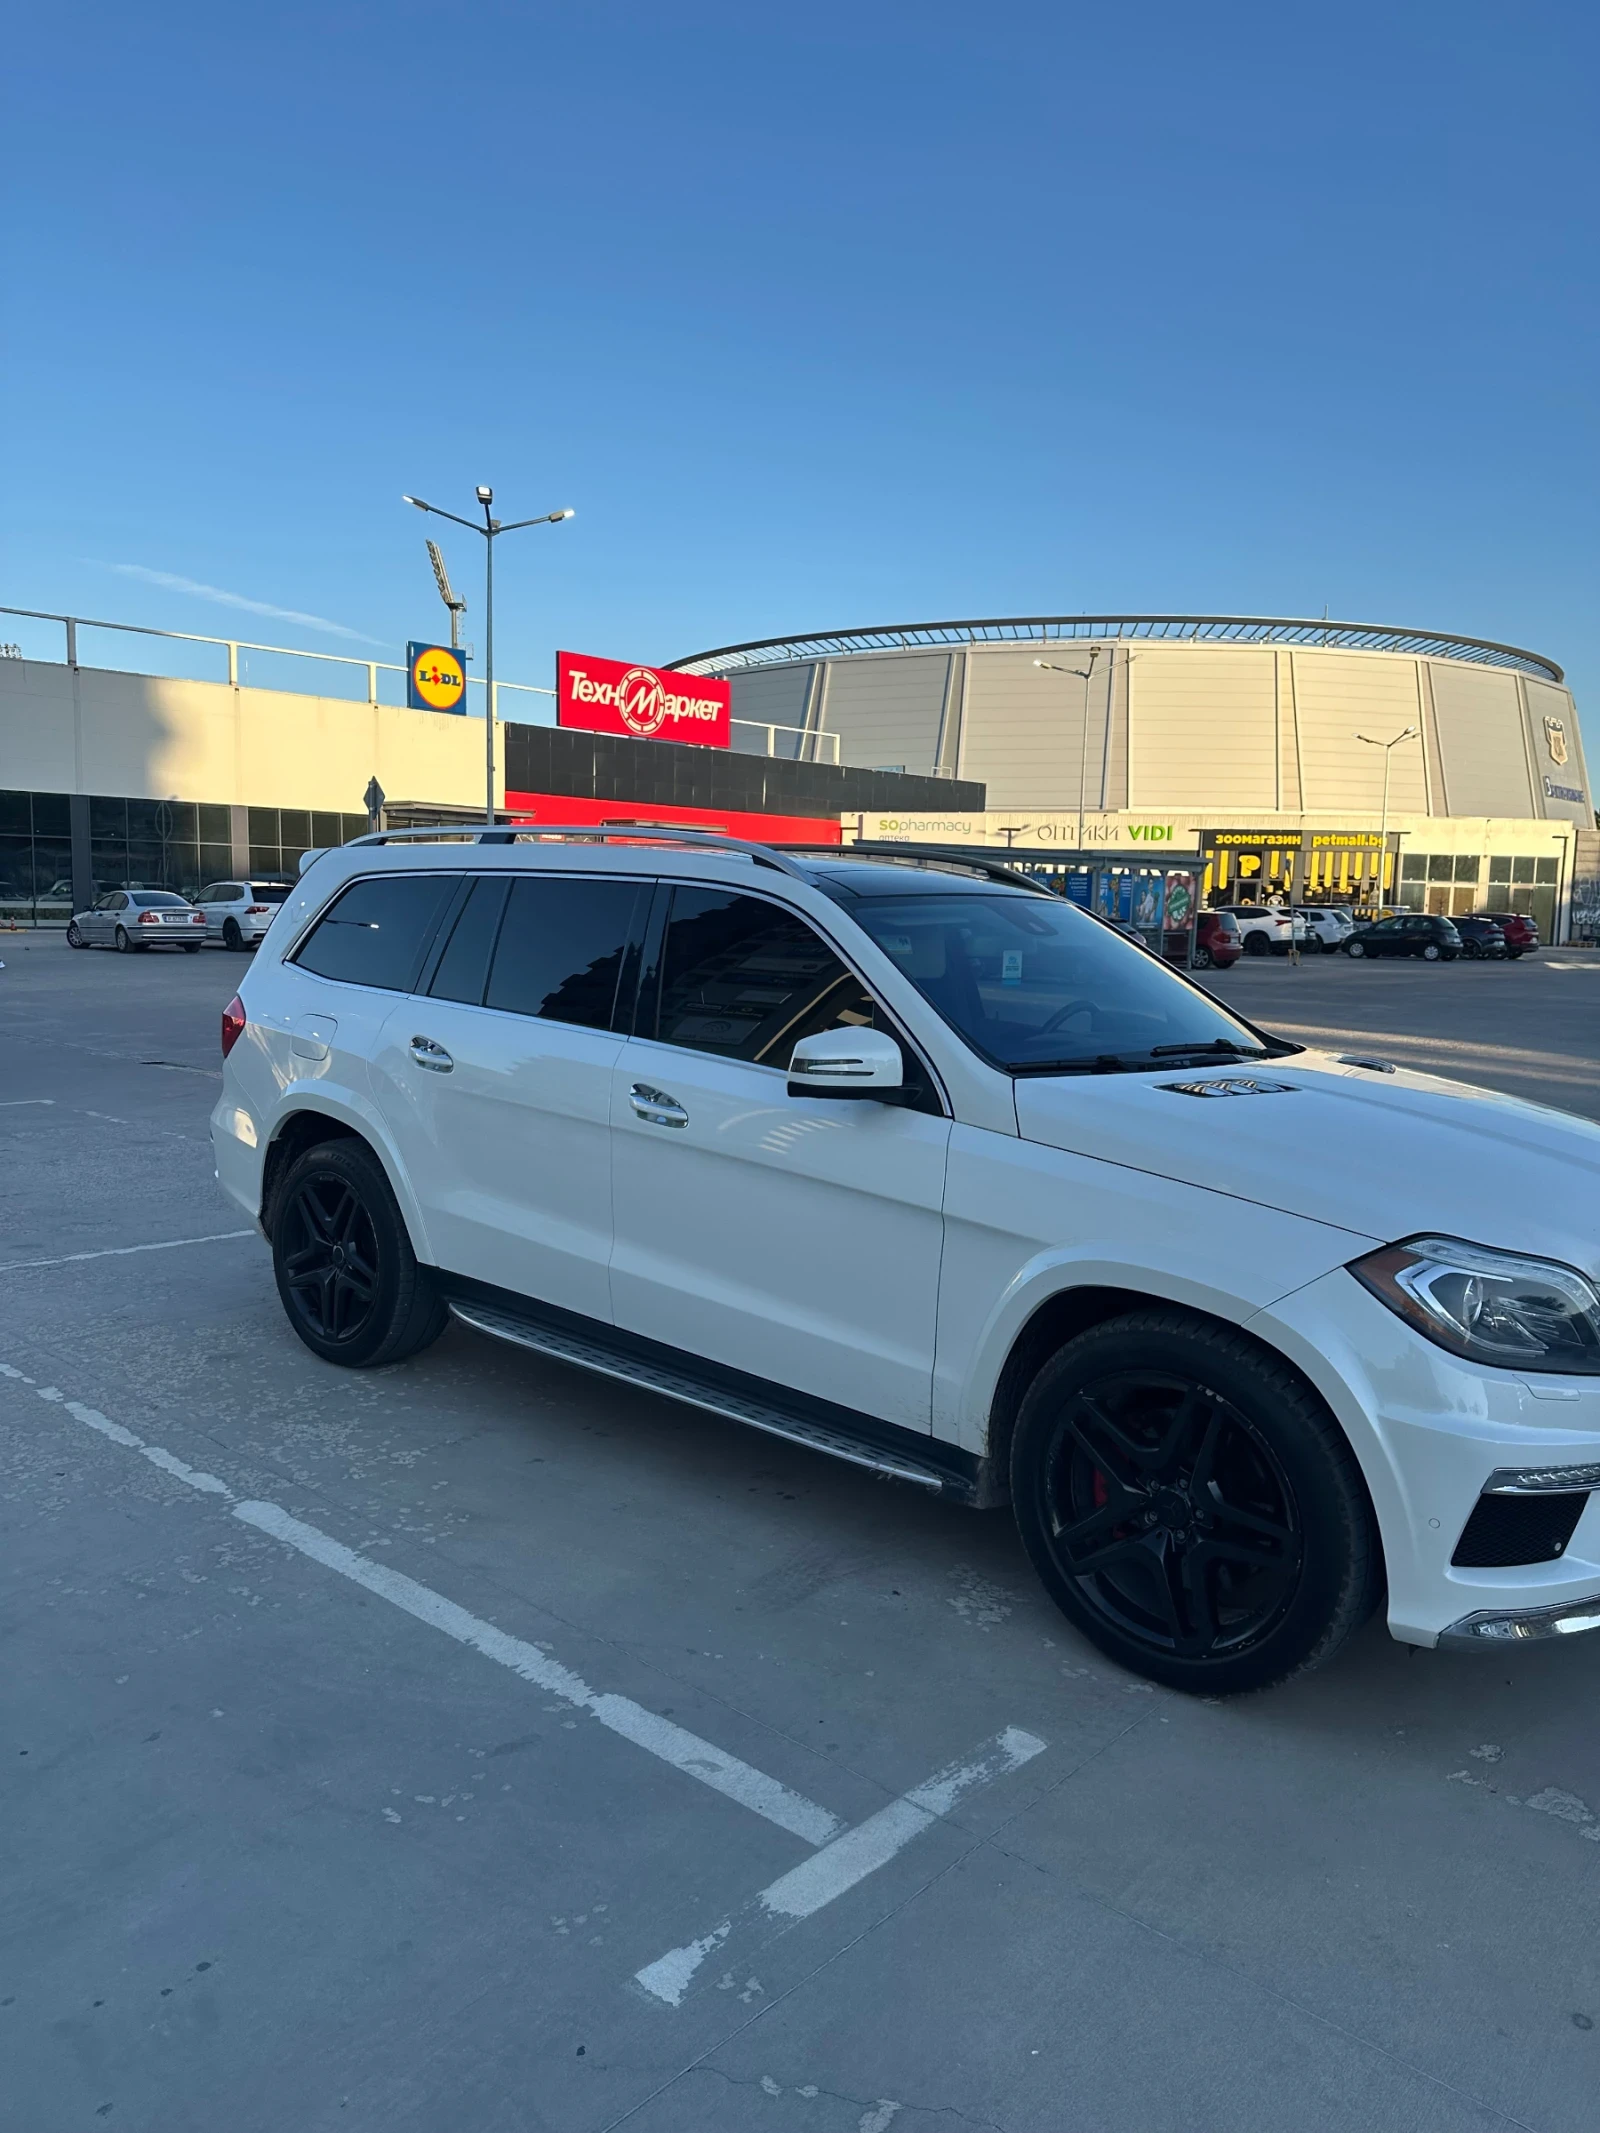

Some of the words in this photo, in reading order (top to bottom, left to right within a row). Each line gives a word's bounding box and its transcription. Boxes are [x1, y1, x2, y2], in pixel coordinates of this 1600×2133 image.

[1127, 825, 1174, 841] VIDI
[1215, 834, 1302, 845] зоомагазин
[1312, 834, 1388, 848] petmall.bg
